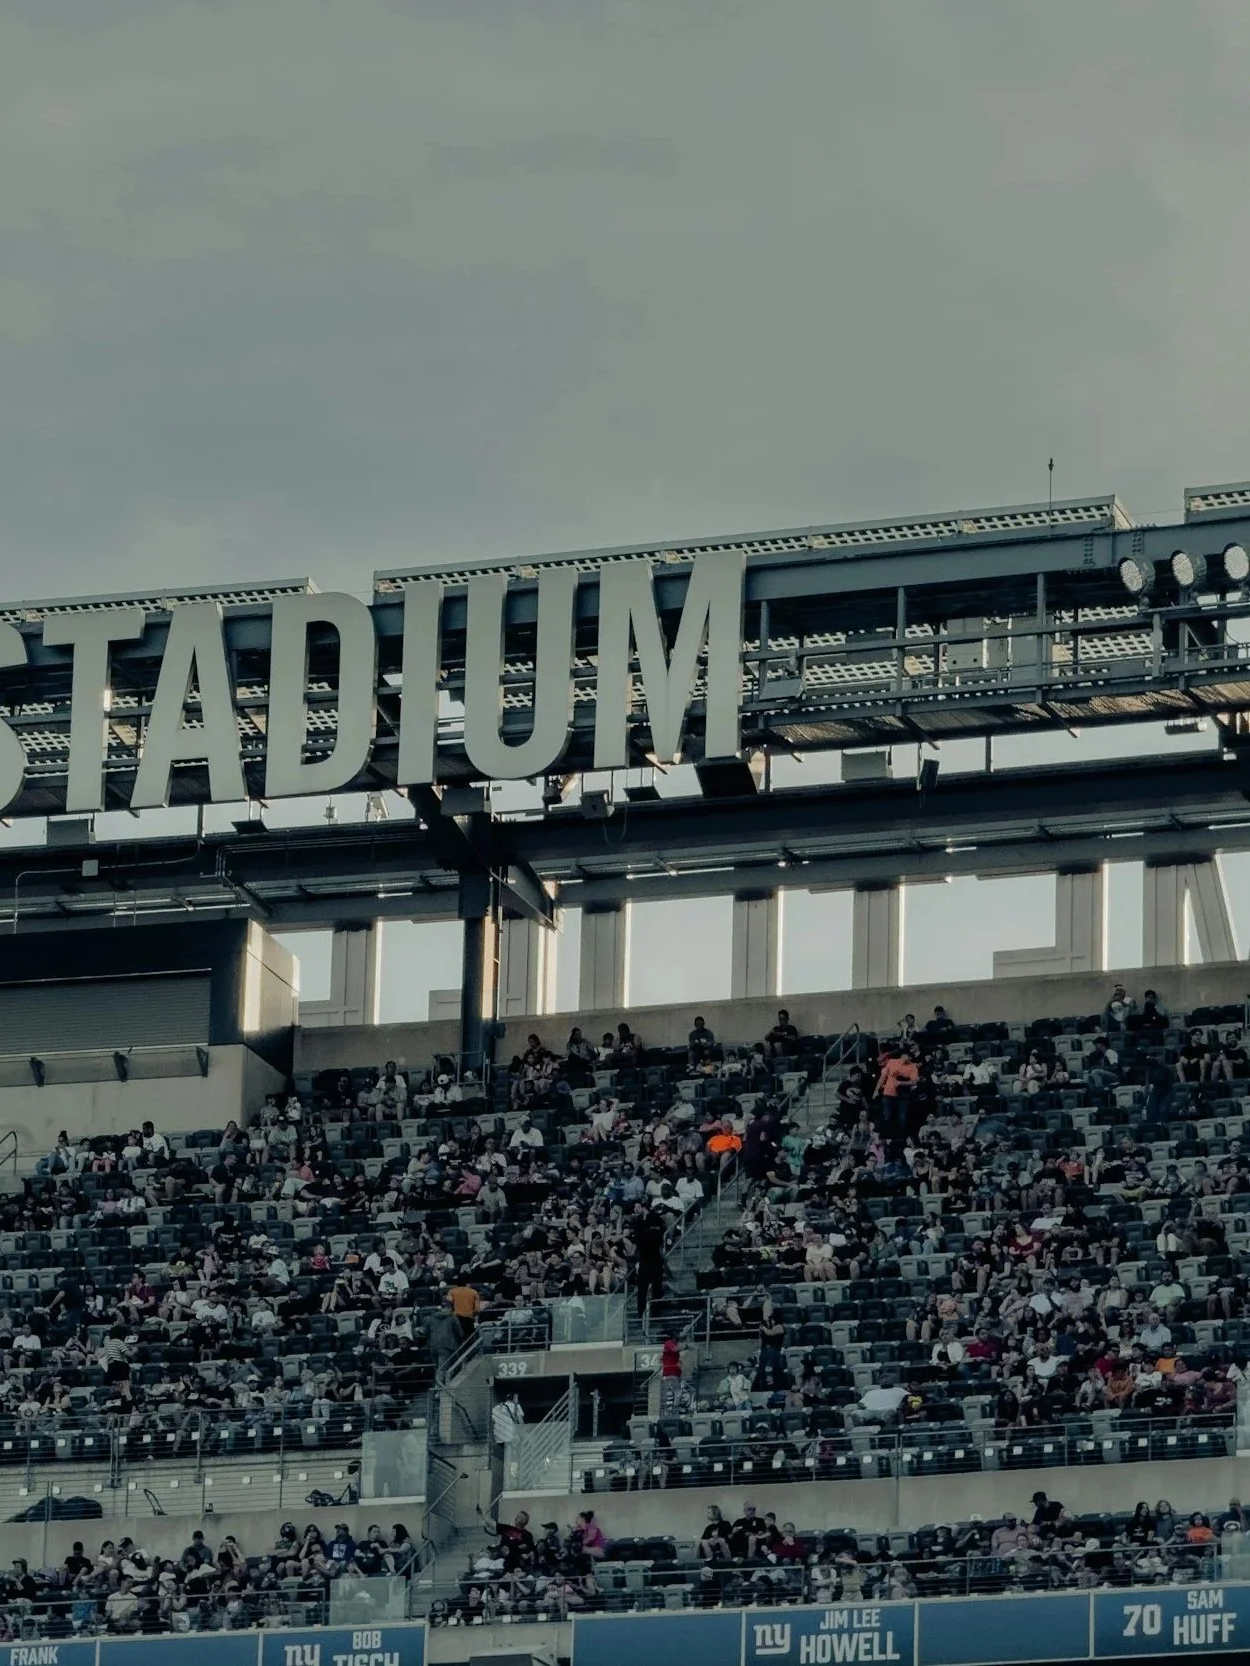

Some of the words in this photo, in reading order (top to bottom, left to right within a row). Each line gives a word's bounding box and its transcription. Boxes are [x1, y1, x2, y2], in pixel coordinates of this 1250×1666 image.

[498, 1361, 527, 1377] 339
[1187, 1589, 1223, 1609] SAM
[819, 1610, 848, 1630] JIM
[853, 1608, 881, 1628] LEE
[1123, 1604, 1161, 1636] 70
[1173, 1613, 1237, 1645] HUFF
[352, 1630, 382, 1650] BOB
[800, 1631, 900, 1664] HOWELL
[10, 1646, 59, 1666] FRANK
